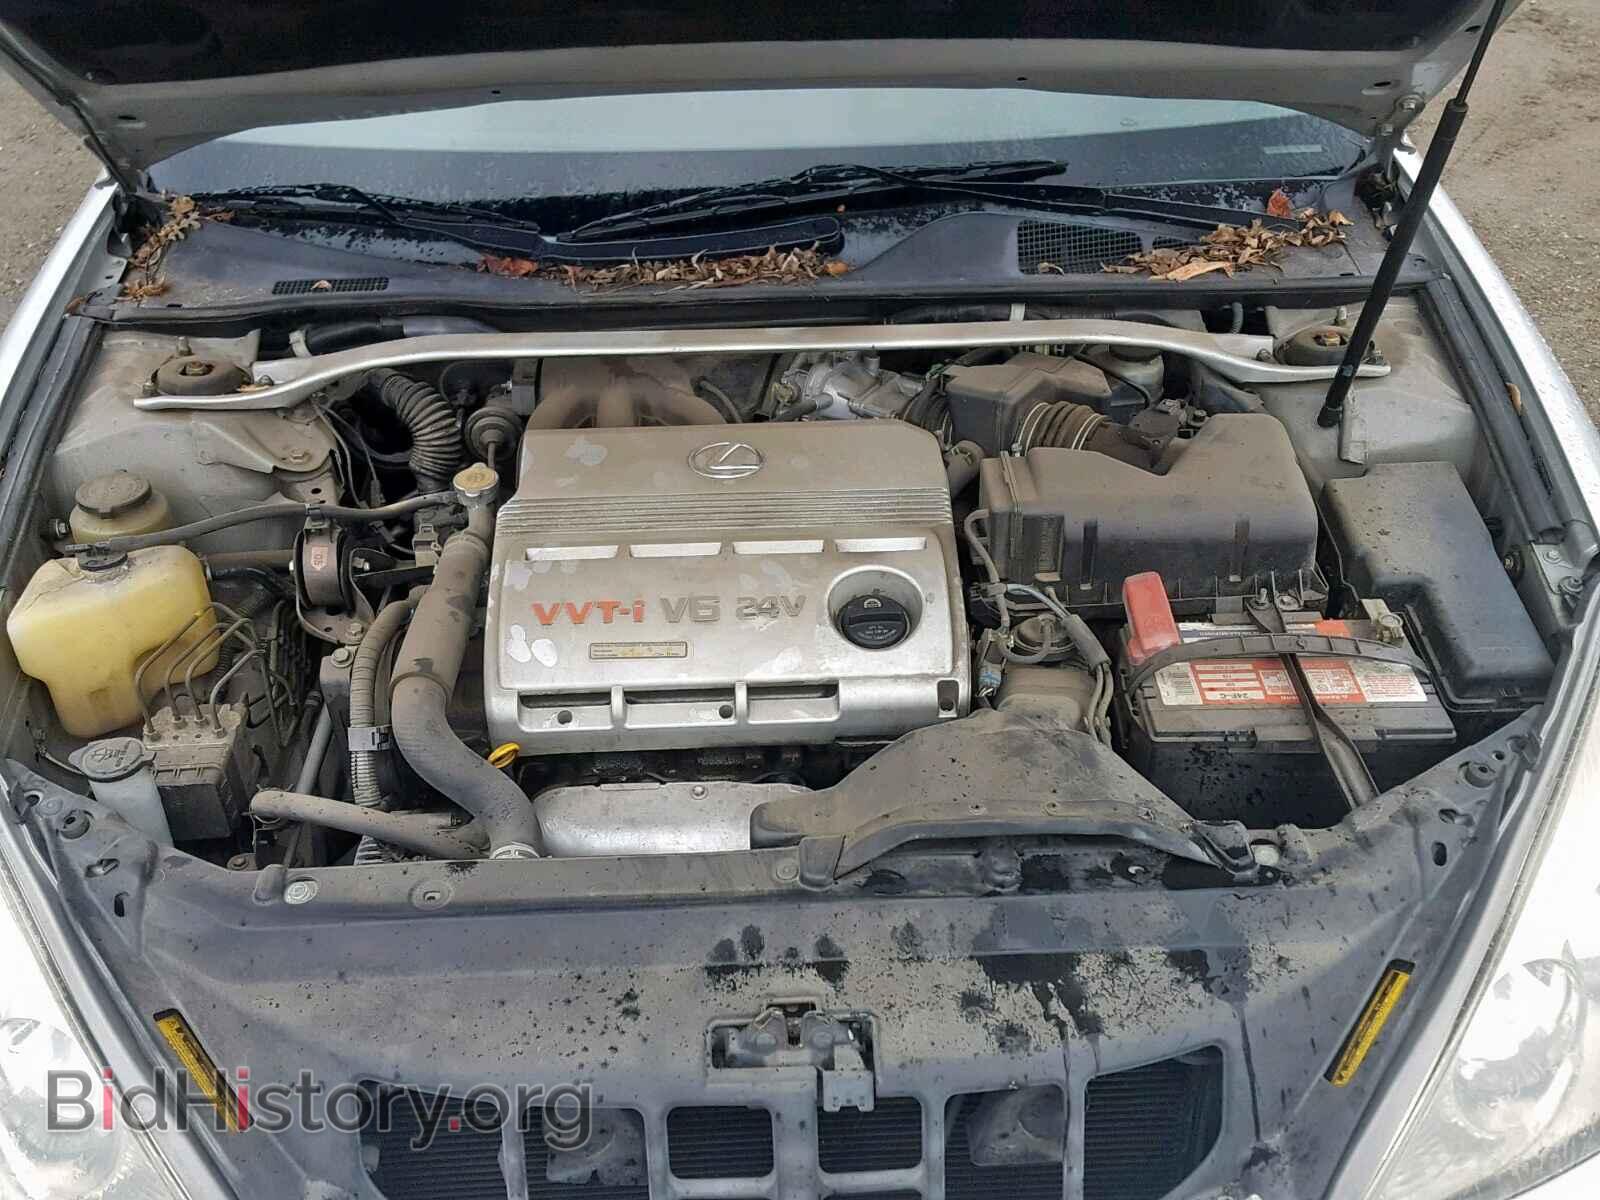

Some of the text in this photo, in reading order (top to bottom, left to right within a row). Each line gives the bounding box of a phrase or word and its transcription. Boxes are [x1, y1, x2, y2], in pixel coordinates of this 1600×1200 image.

[532, 595, 806, 626] VVT-i V6 24V
